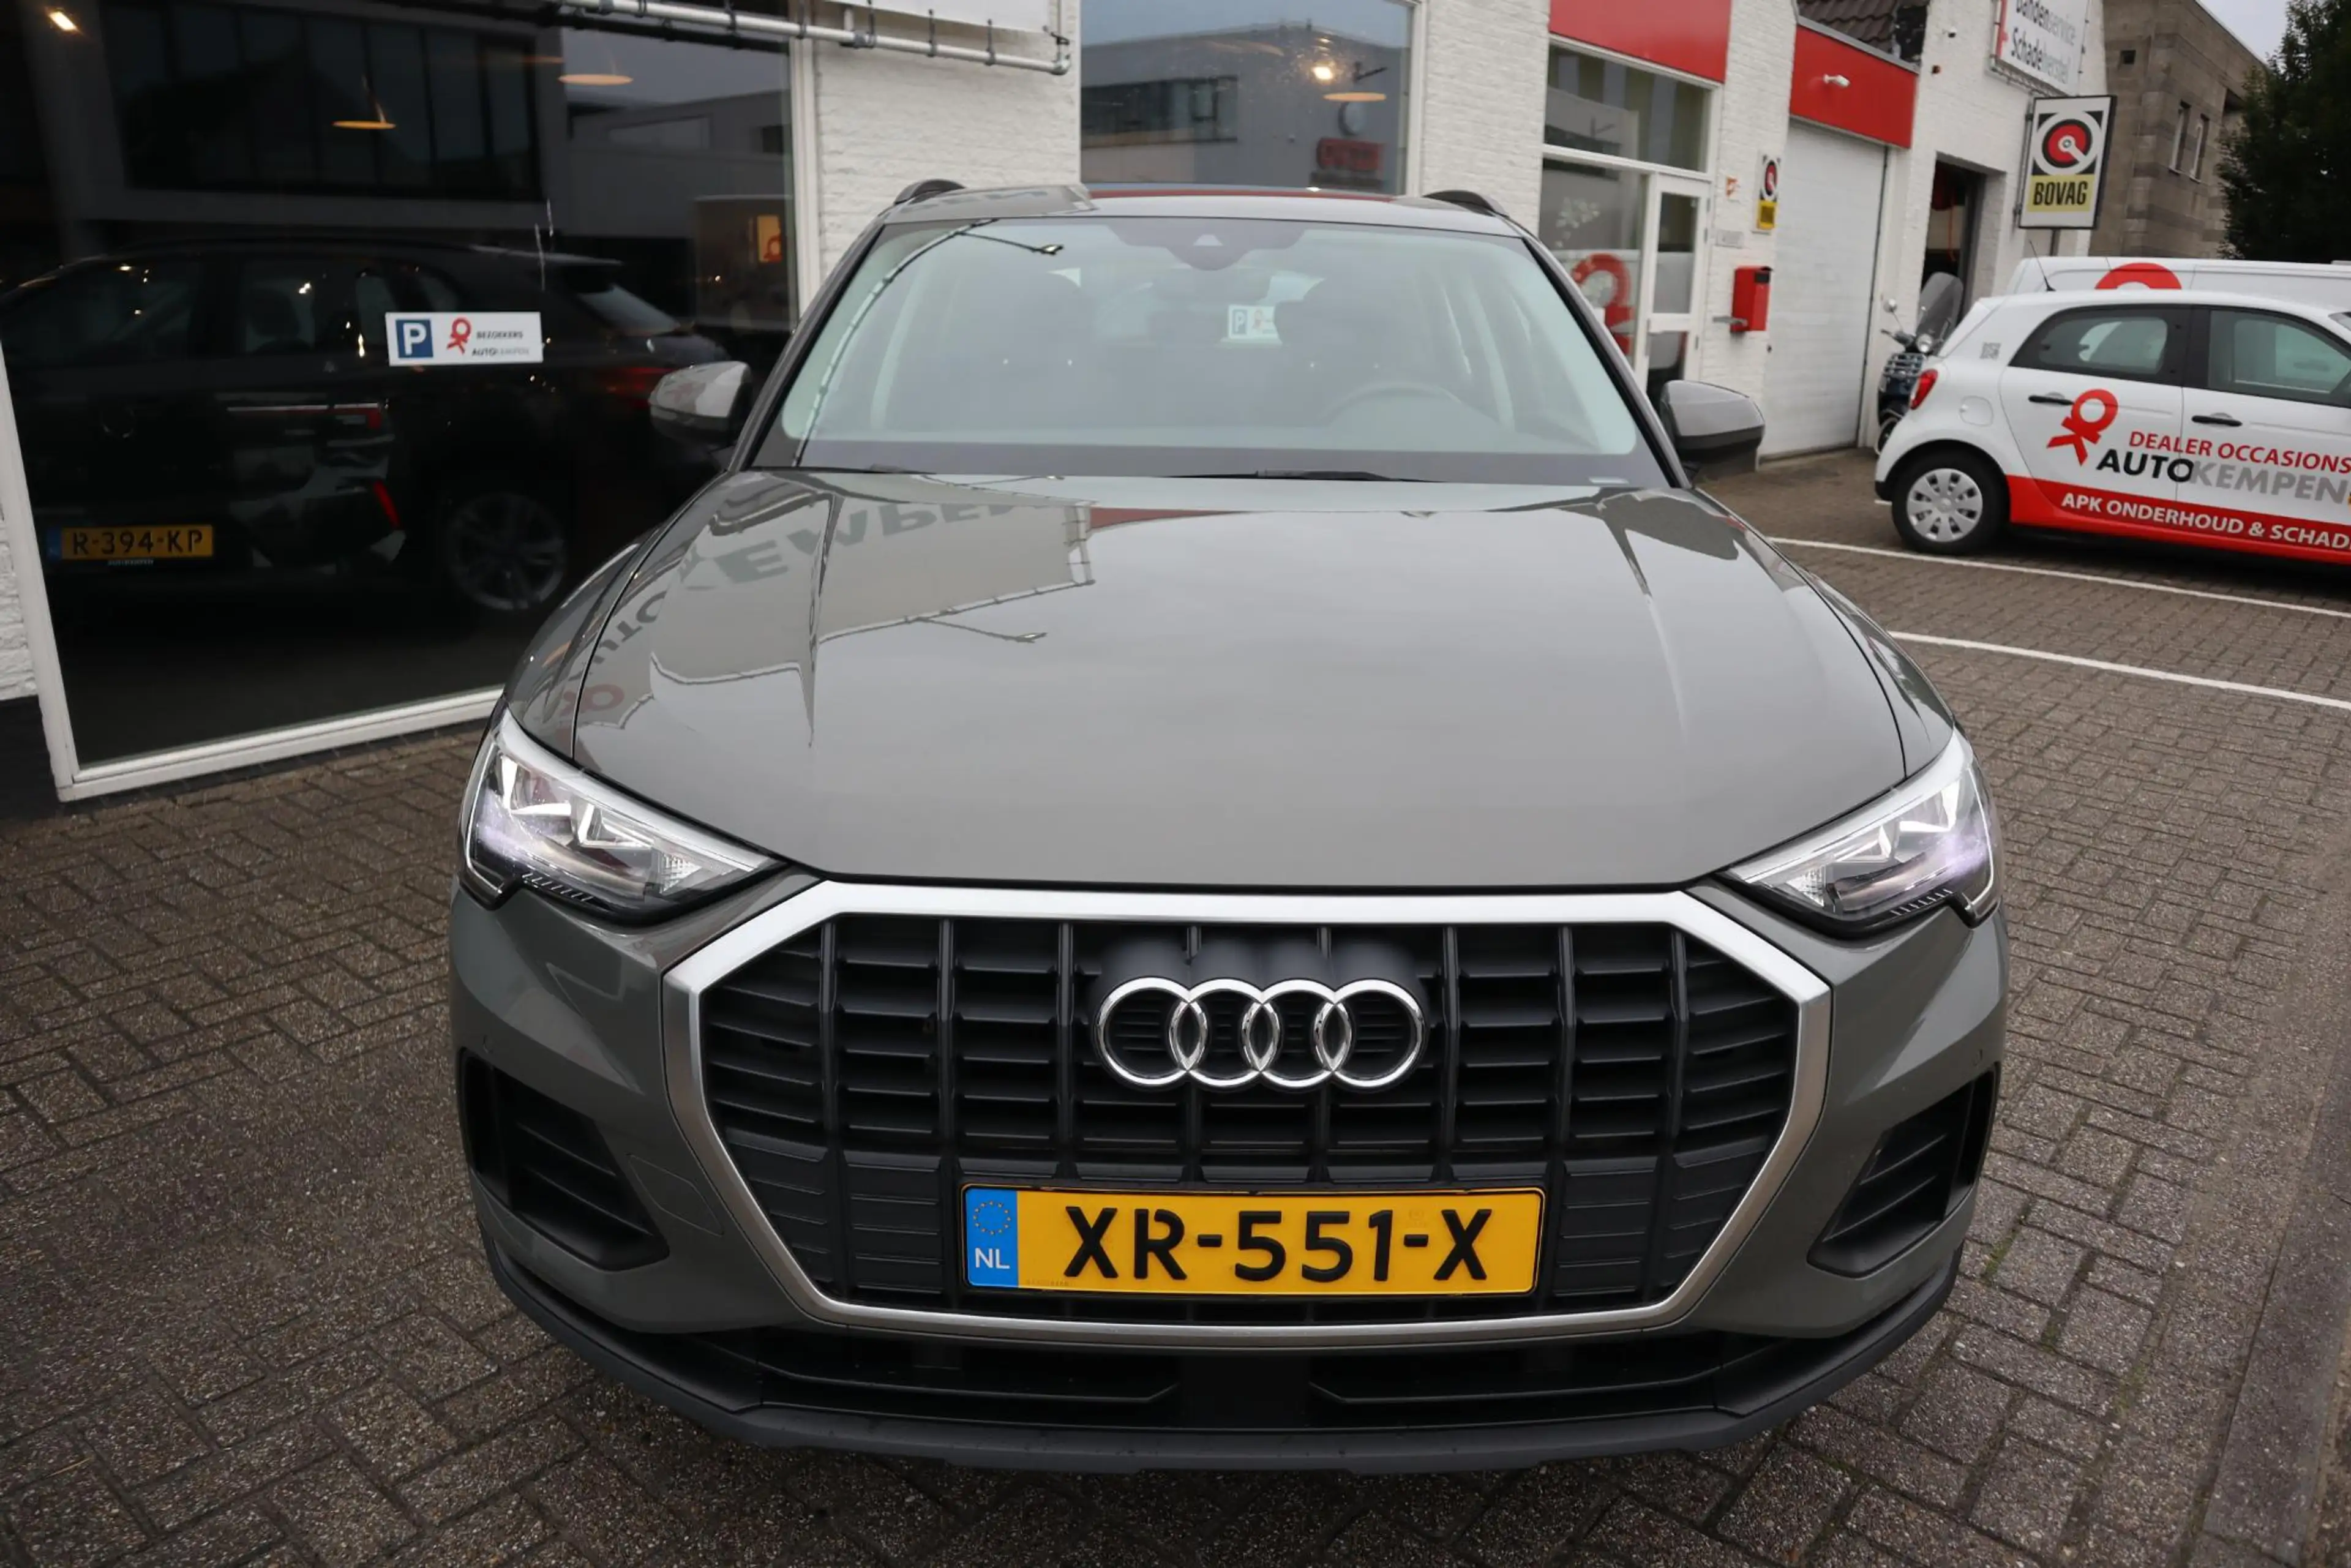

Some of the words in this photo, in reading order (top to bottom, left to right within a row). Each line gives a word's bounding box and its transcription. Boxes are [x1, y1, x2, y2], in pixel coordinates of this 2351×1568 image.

[2033, 181, 2088, 206] BOVAG
[2129, 430, 2212, 457] DEALER
[2218, 442, 2351, 475] OCCASIONS
[2096, 449, 2349, 505] AUTOKEMPEN
[73, 530, 203, 555] R-394-KP
[2061, 492, 2102, 514] APK
[2106, 499, 2244, 535] ONDERHOUD
[2249, 521, 2266, 538] &
[2269, 523, 2351, 551] SCHAD
[975, 1247, 1011, 1269] NL
[1063, 1205, 1493, 1283] XR-551-X
